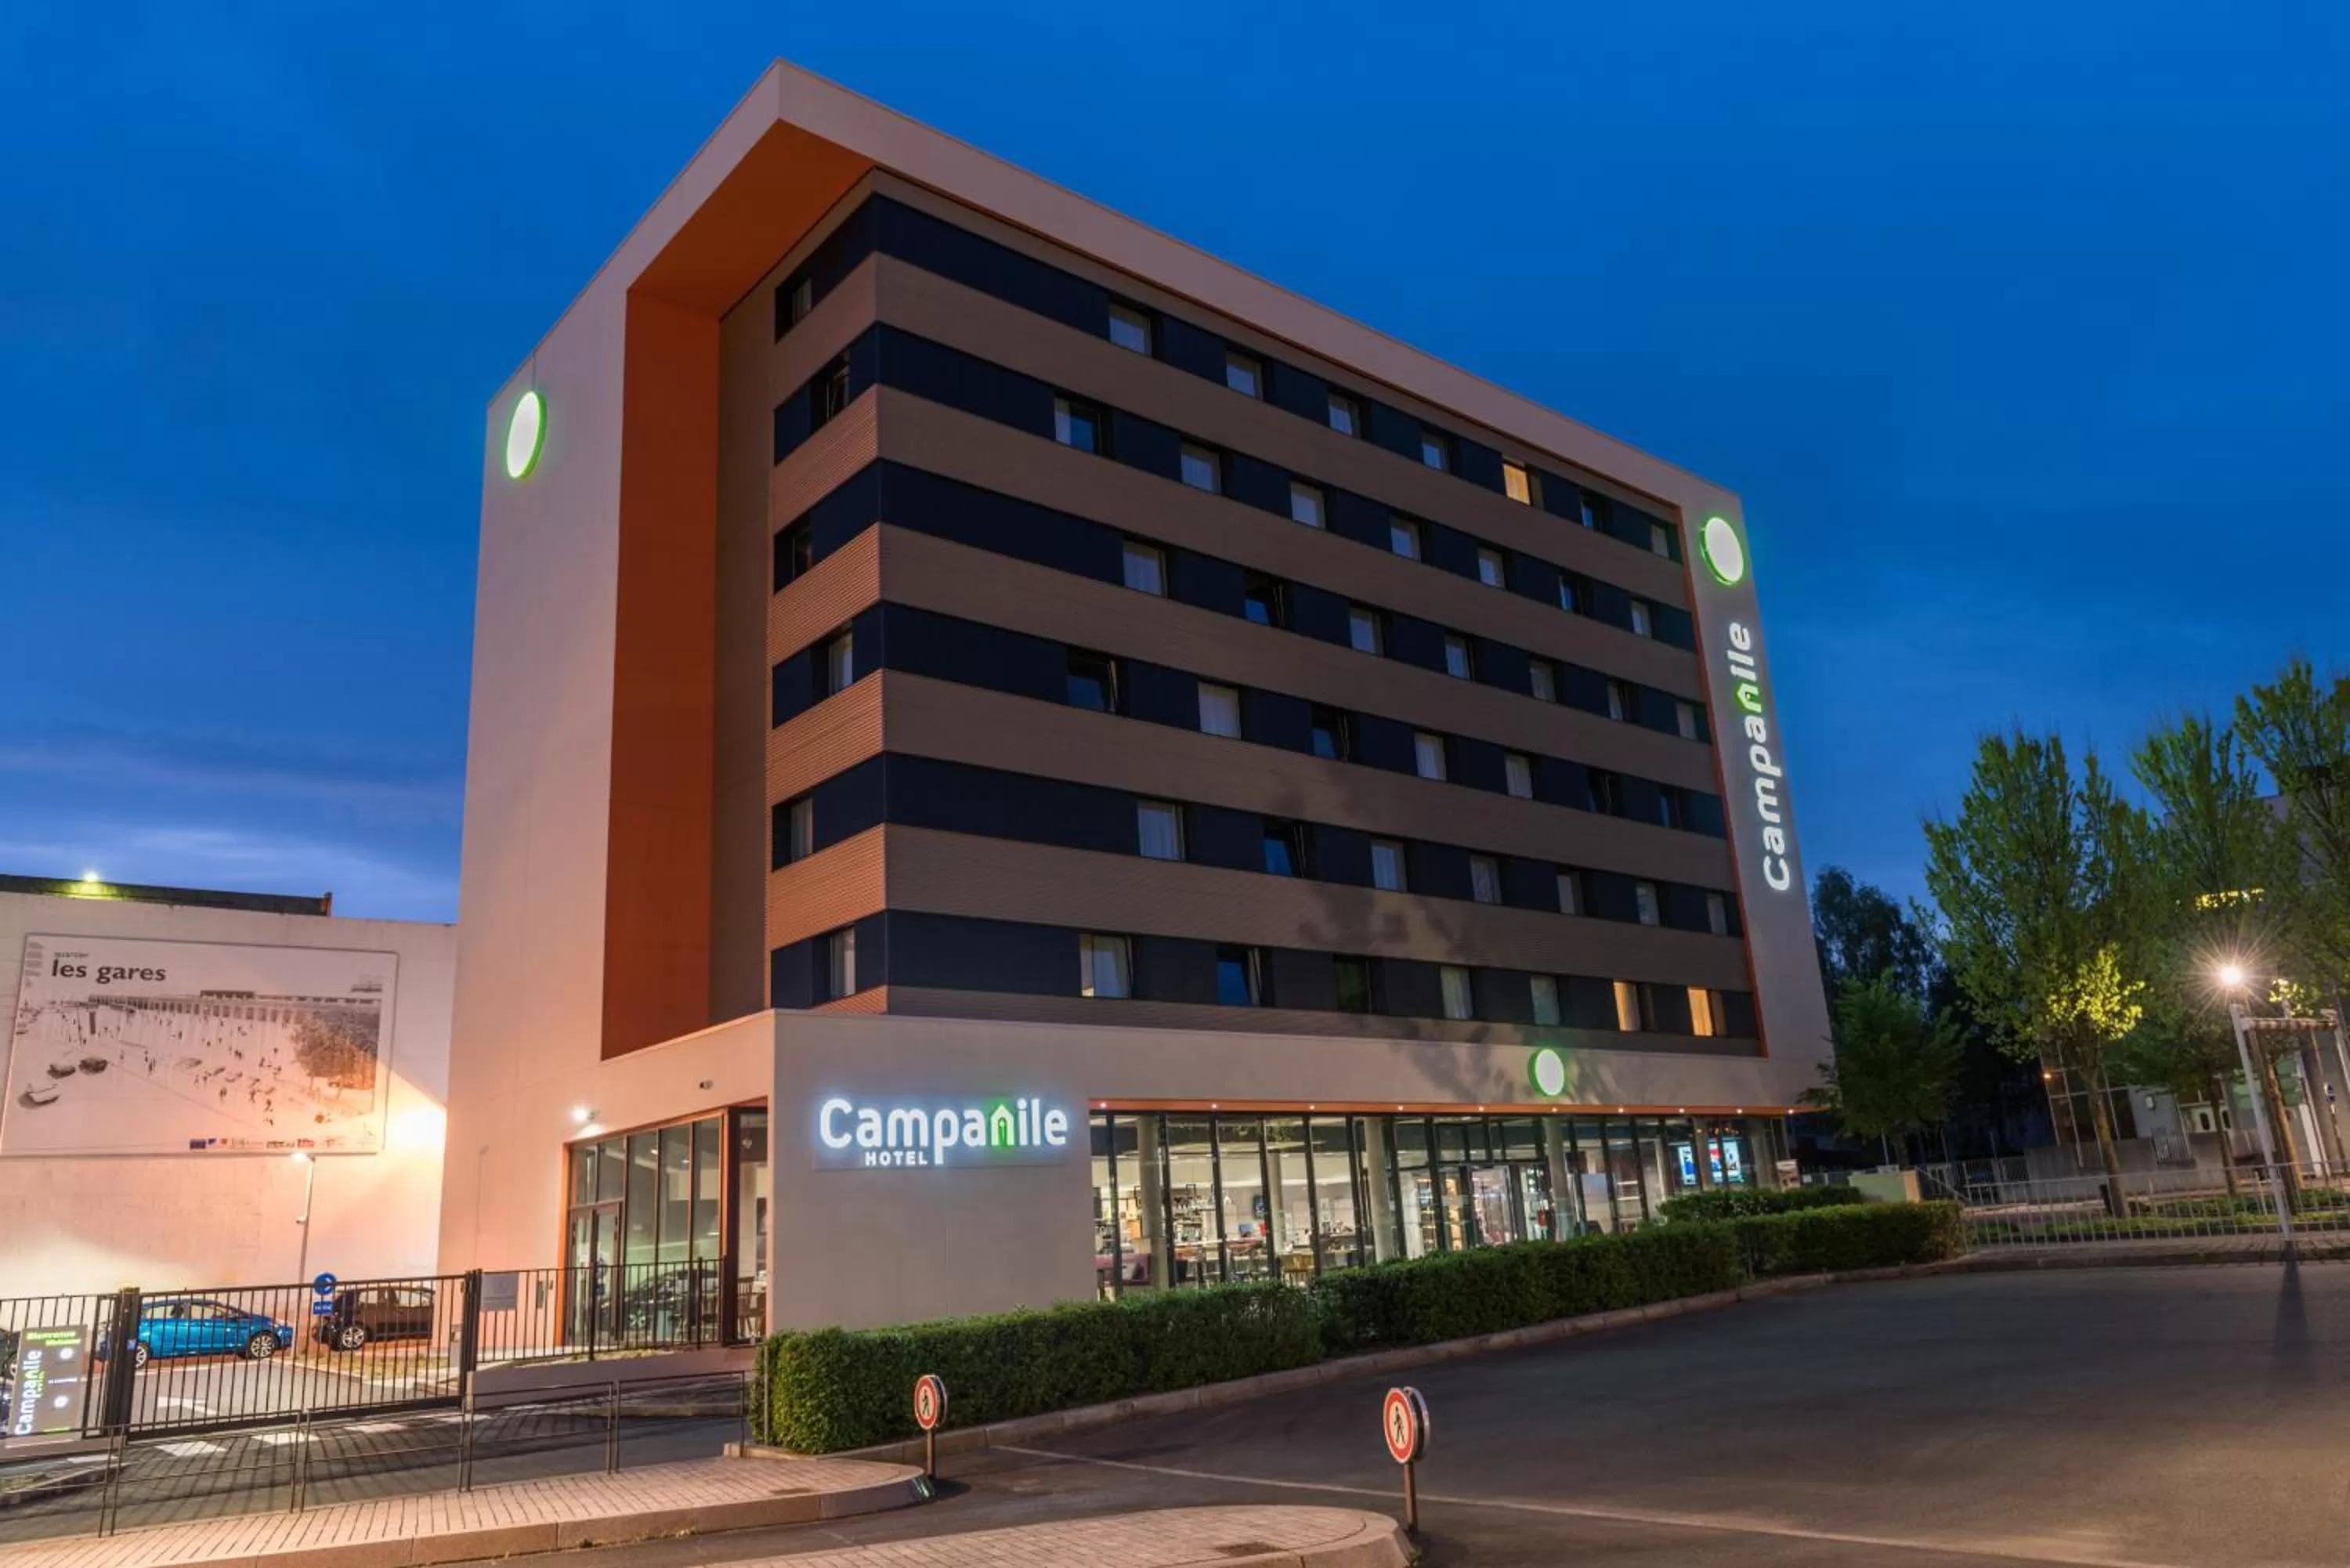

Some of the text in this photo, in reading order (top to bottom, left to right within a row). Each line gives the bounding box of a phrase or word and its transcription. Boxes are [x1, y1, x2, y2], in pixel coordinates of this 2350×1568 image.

[1727, 622, 1791, 891] Campanile
[51, 959, 88, 978] les
[95, 964, 167, 985] gares
[820, 1097, 1068, 1165] Campanile
[864, 1151, 928, 1166] HOTEL
[14, 1349, 43, 1435] Campanile
